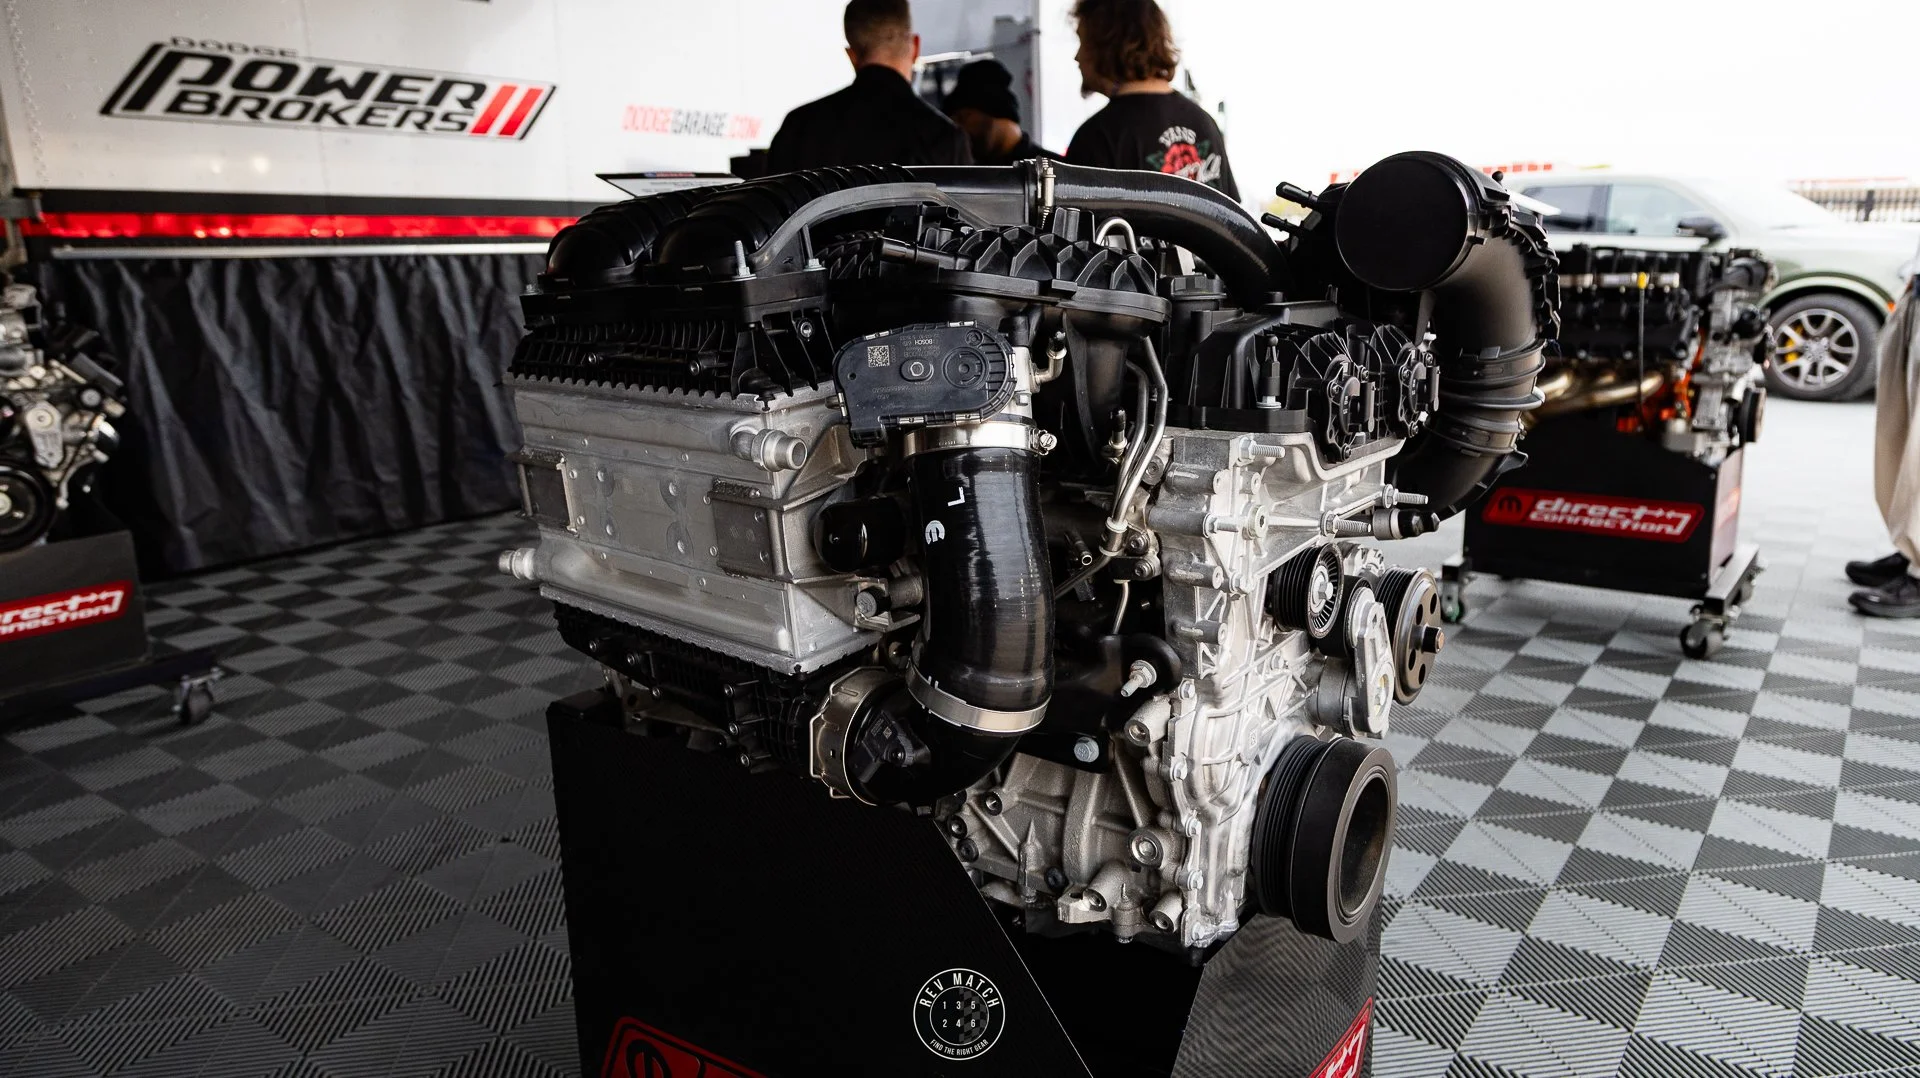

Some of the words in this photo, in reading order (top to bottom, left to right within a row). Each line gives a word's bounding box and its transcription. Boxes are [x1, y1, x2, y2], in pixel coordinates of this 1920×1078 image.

[170, 36, 297, 58] DODGE
[121, 50, 488, 112] POWER
[164, 89, 475, 133] BROKERS
[1159, 126, 1196, 147] VANS
